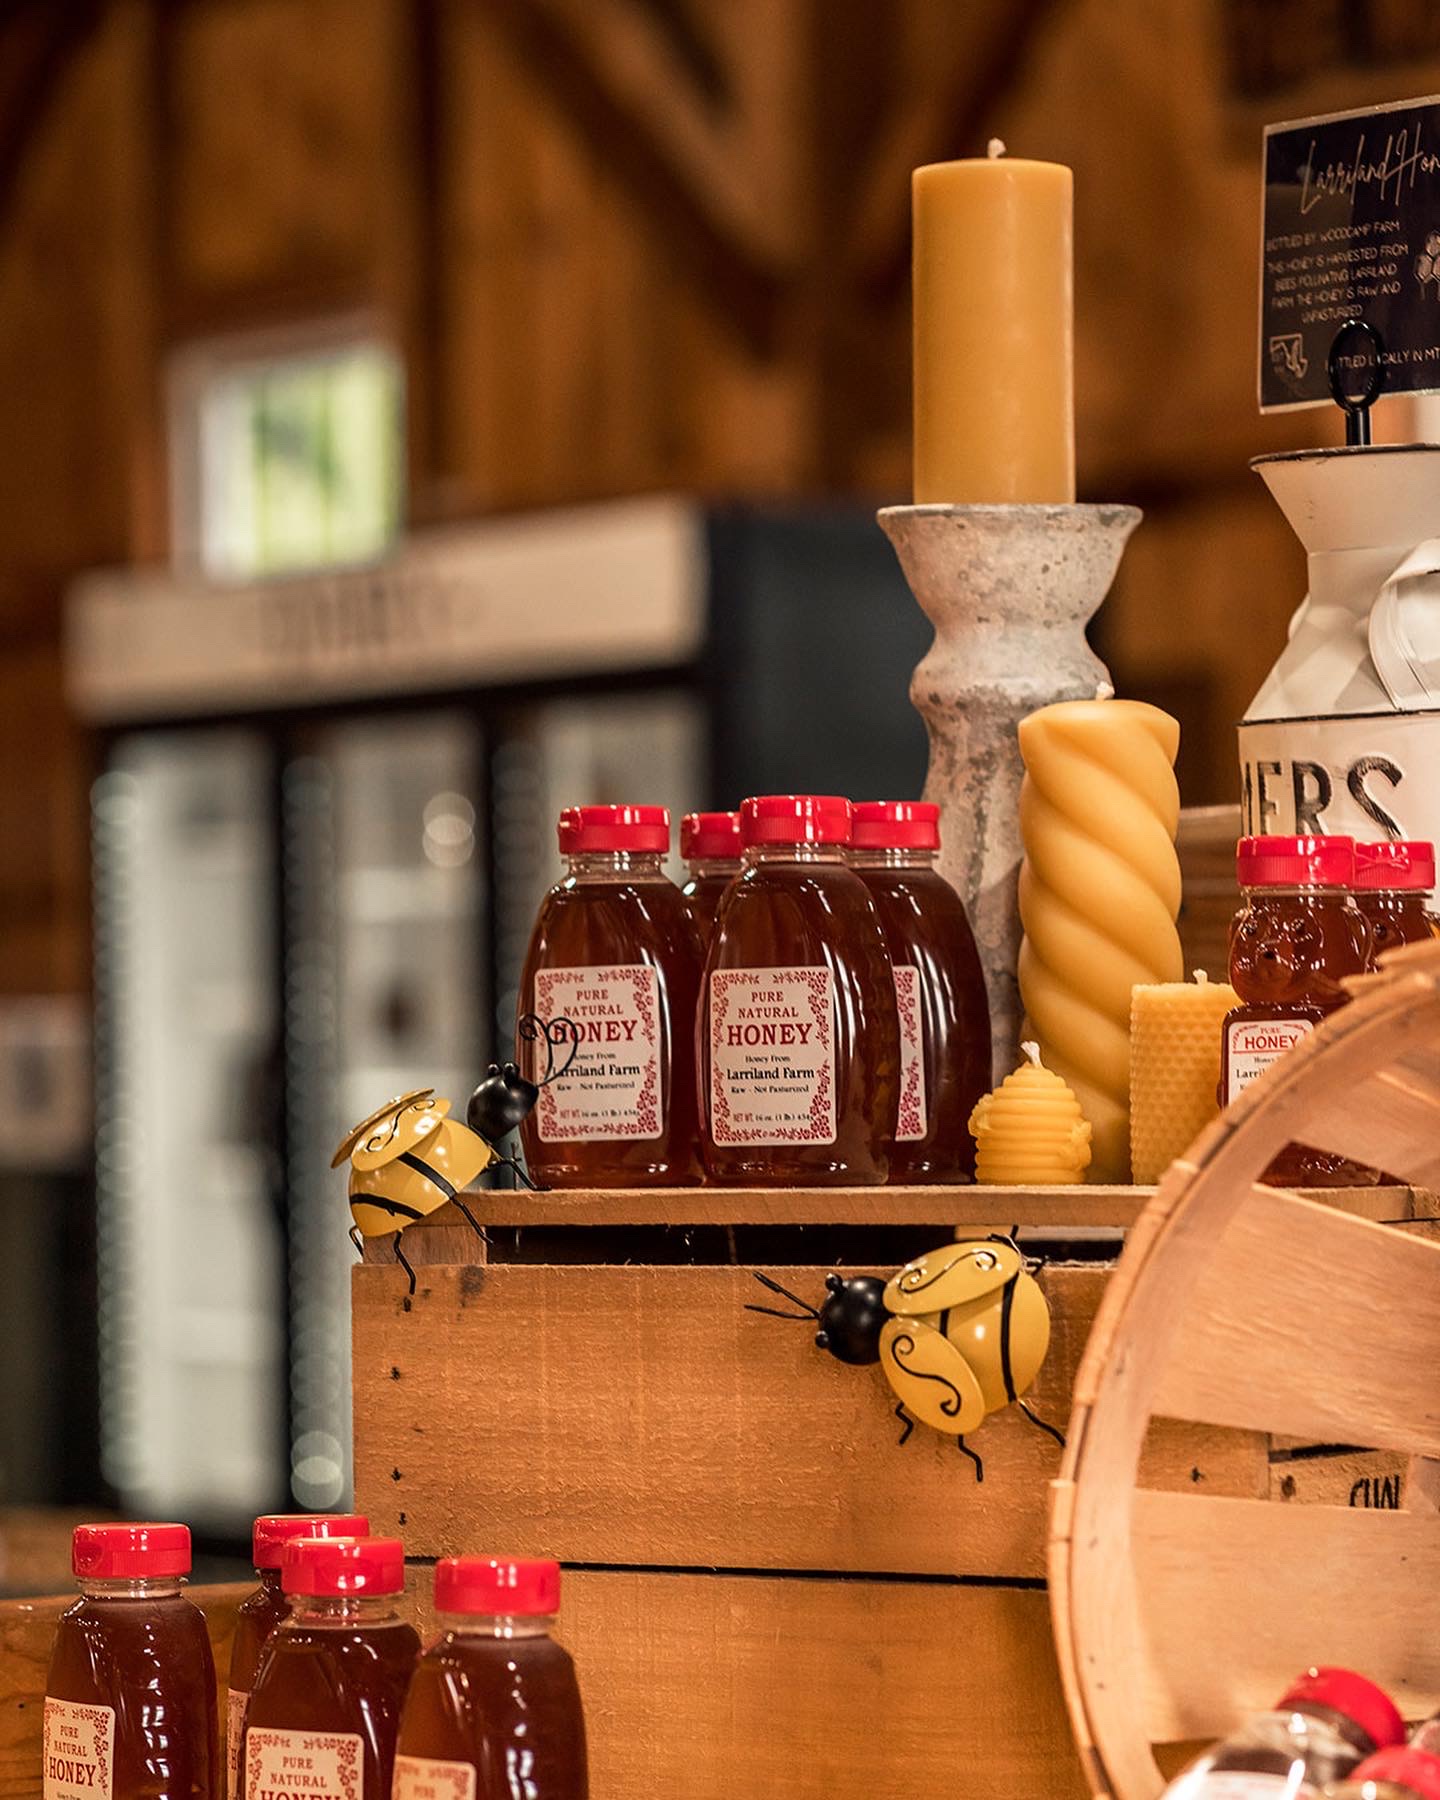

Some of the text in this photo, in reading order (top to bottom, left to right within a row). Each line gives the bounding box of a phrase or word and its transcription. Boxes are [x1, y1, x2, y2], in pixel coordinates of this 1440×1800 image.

[1373, 220, 1400, 234] FARM
[1326, 247, 1378, 265] HARVESTED
[1379, 243, 1409, 258] FROM
[1298, 268, 1349, 288] POLLINATING
[1314, 288, 1343, 302] HONEY
[1356, 284, 1379, 297] RAW
[1380, 280, 1401, 295] AND
[577, 989, 609, 1001] PURE
[751, 991, 784, 1003] PURE
[564, 1004, 624, 1017] NATURAL
[738, 1006, 799, 1019] NATURAL
[727, 1023, 813, 1047] HONEY
[1244, 1034, 1299, 1050] HONEY
[609, 1063, 640, 1076] Farm
[727, 1067, 815, 1080] Larriland Farm
[60, 1725, 79, 1739] PURE
[54, 1740, 88, 1757] NATURAL
[282, 1755, 313, 1769] PURE
[49, 1756, 96, 1787] HONEY
[270, 1772, 327, 1788] NATURAL
